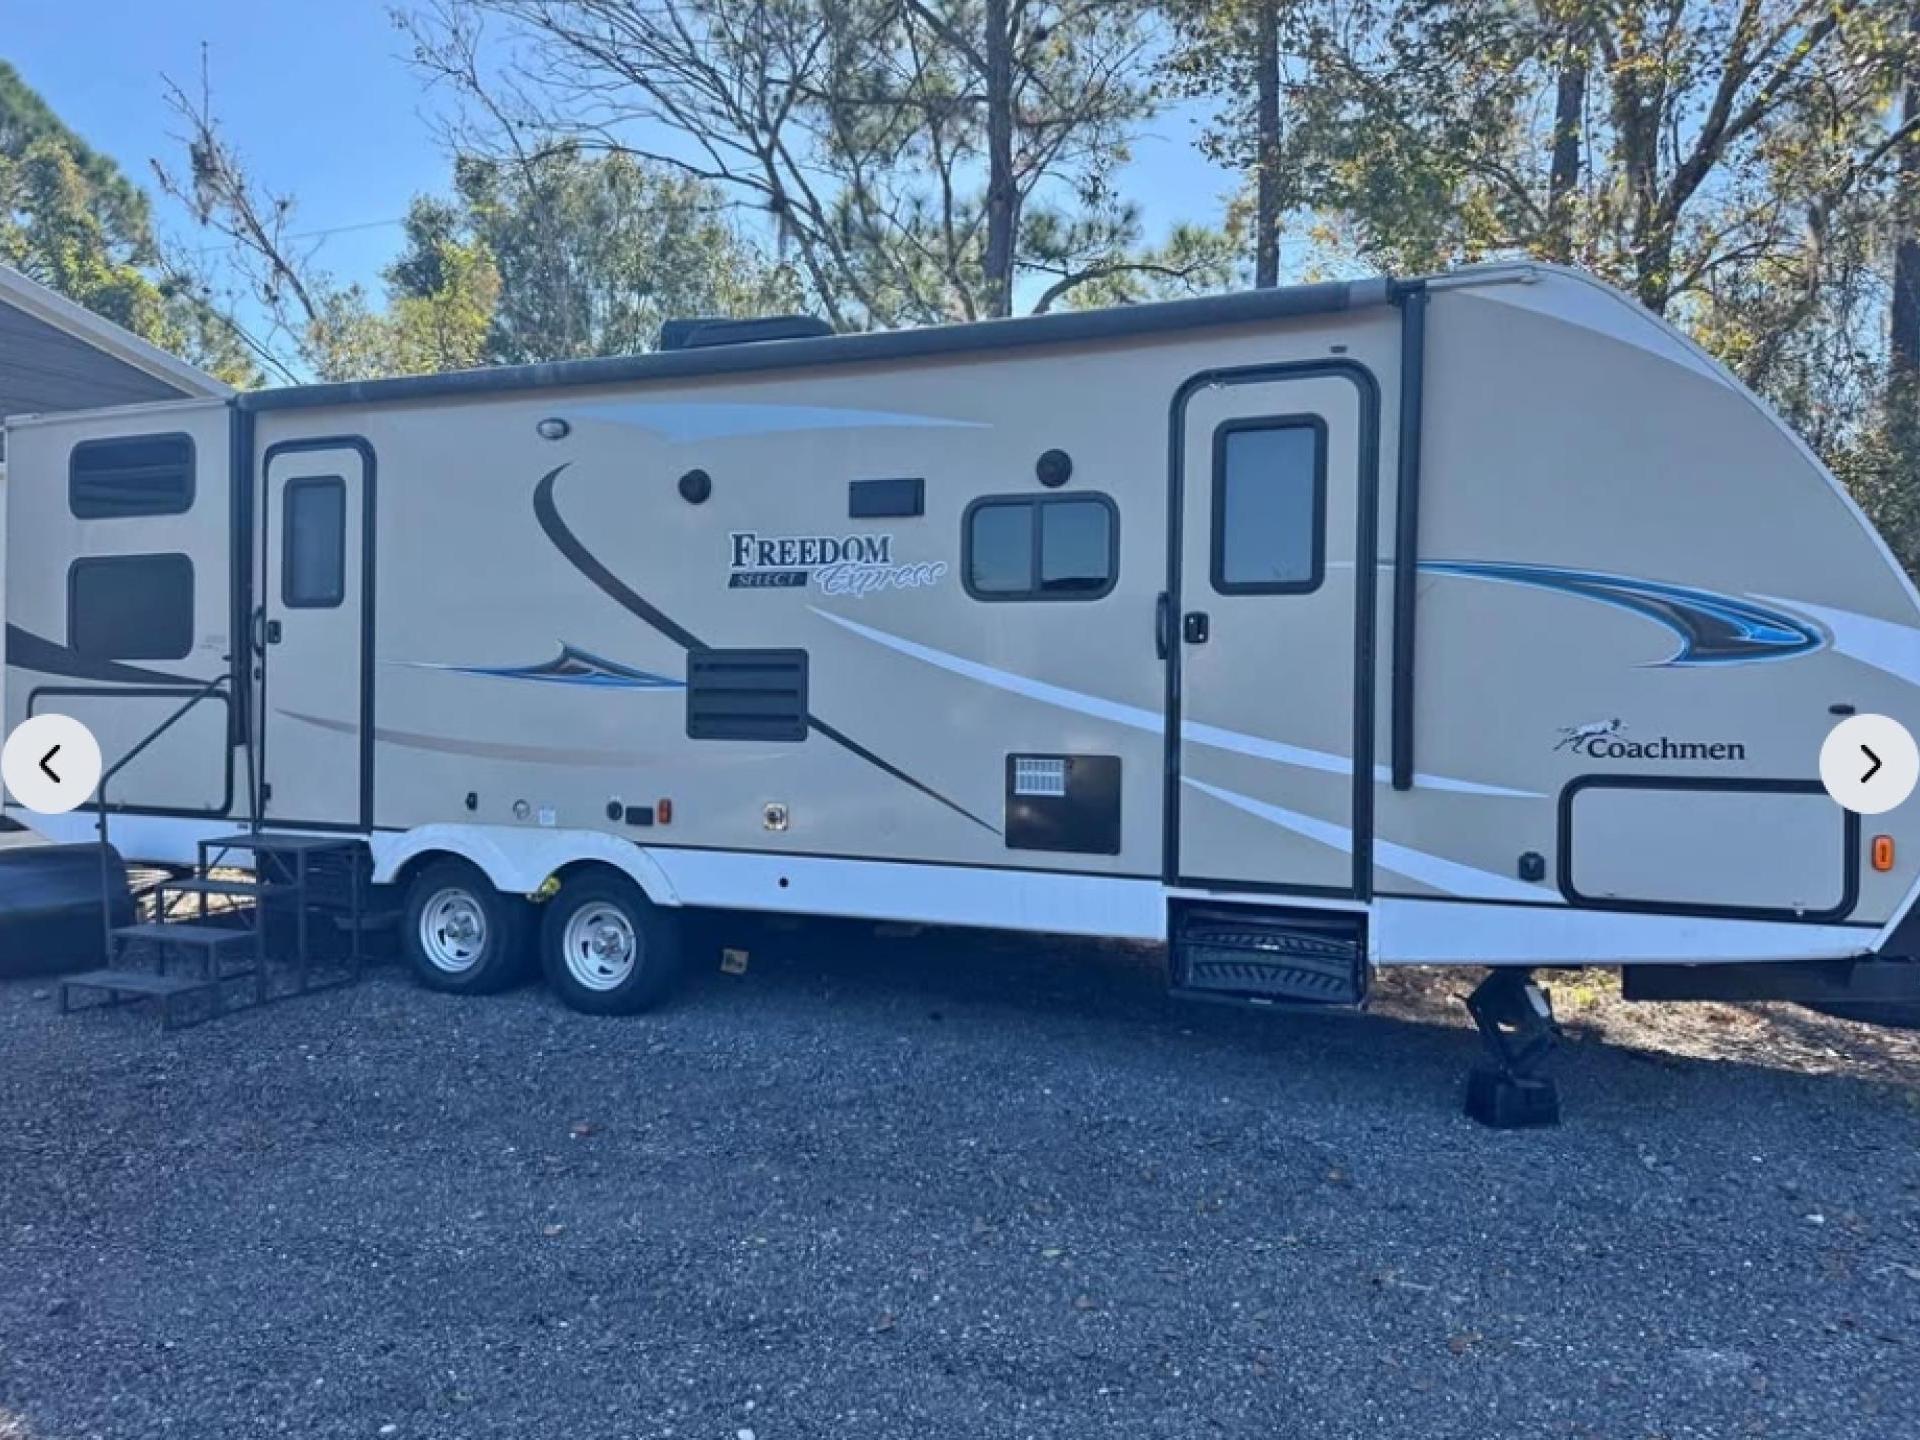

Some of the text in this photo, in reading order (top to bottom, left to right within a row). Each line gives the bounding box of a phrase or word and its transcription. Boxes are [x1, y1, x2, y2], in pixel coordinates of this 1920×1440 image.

[731, 532, 891, 567] FREEDOM
[738, 573, 797, 586] SELECT
[814, 562, 947, 597] Express
[1587, 737, 1745, 760] Coachmen
